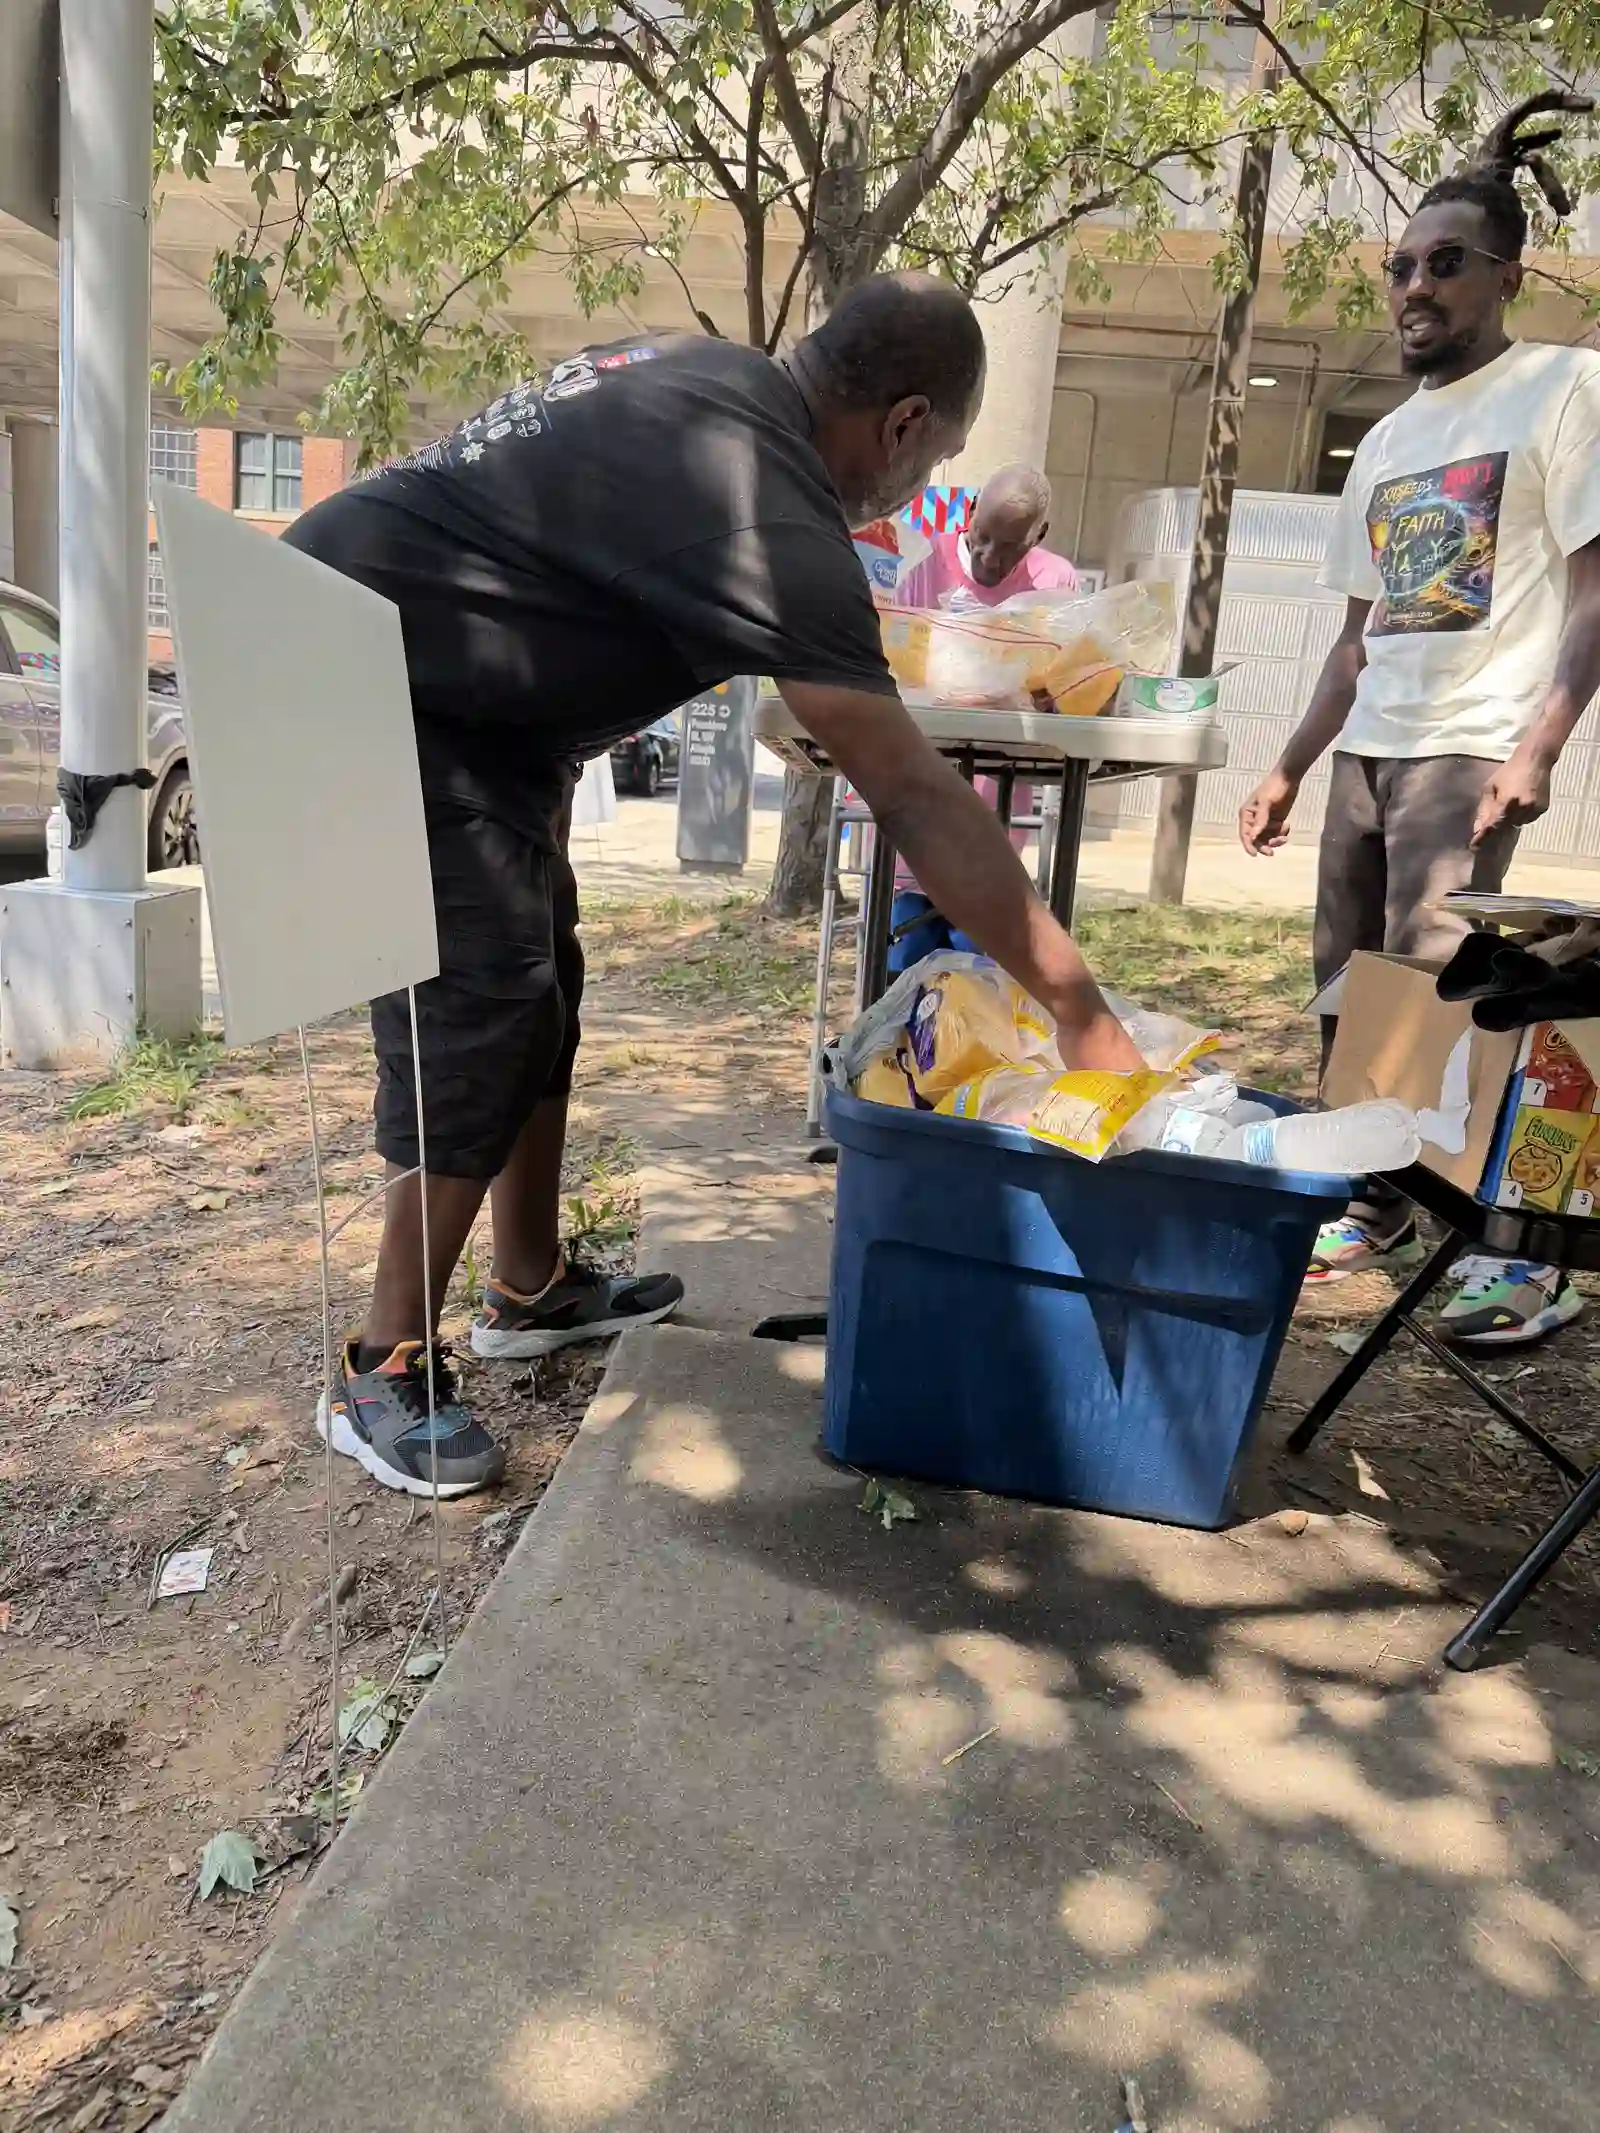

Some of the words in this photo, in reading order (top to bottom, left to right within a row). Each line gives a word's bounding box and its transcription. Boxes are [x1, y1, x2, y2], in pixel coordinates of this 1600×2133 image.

[1395, 510, 1446, 539] FAITH
[692, 702, 716, 716] 225
[1533, 1083, 1542, 1095] 7
[1508, 1184, 1517, 1197] 4
[1580, 1194, 1589, 1205] 5
